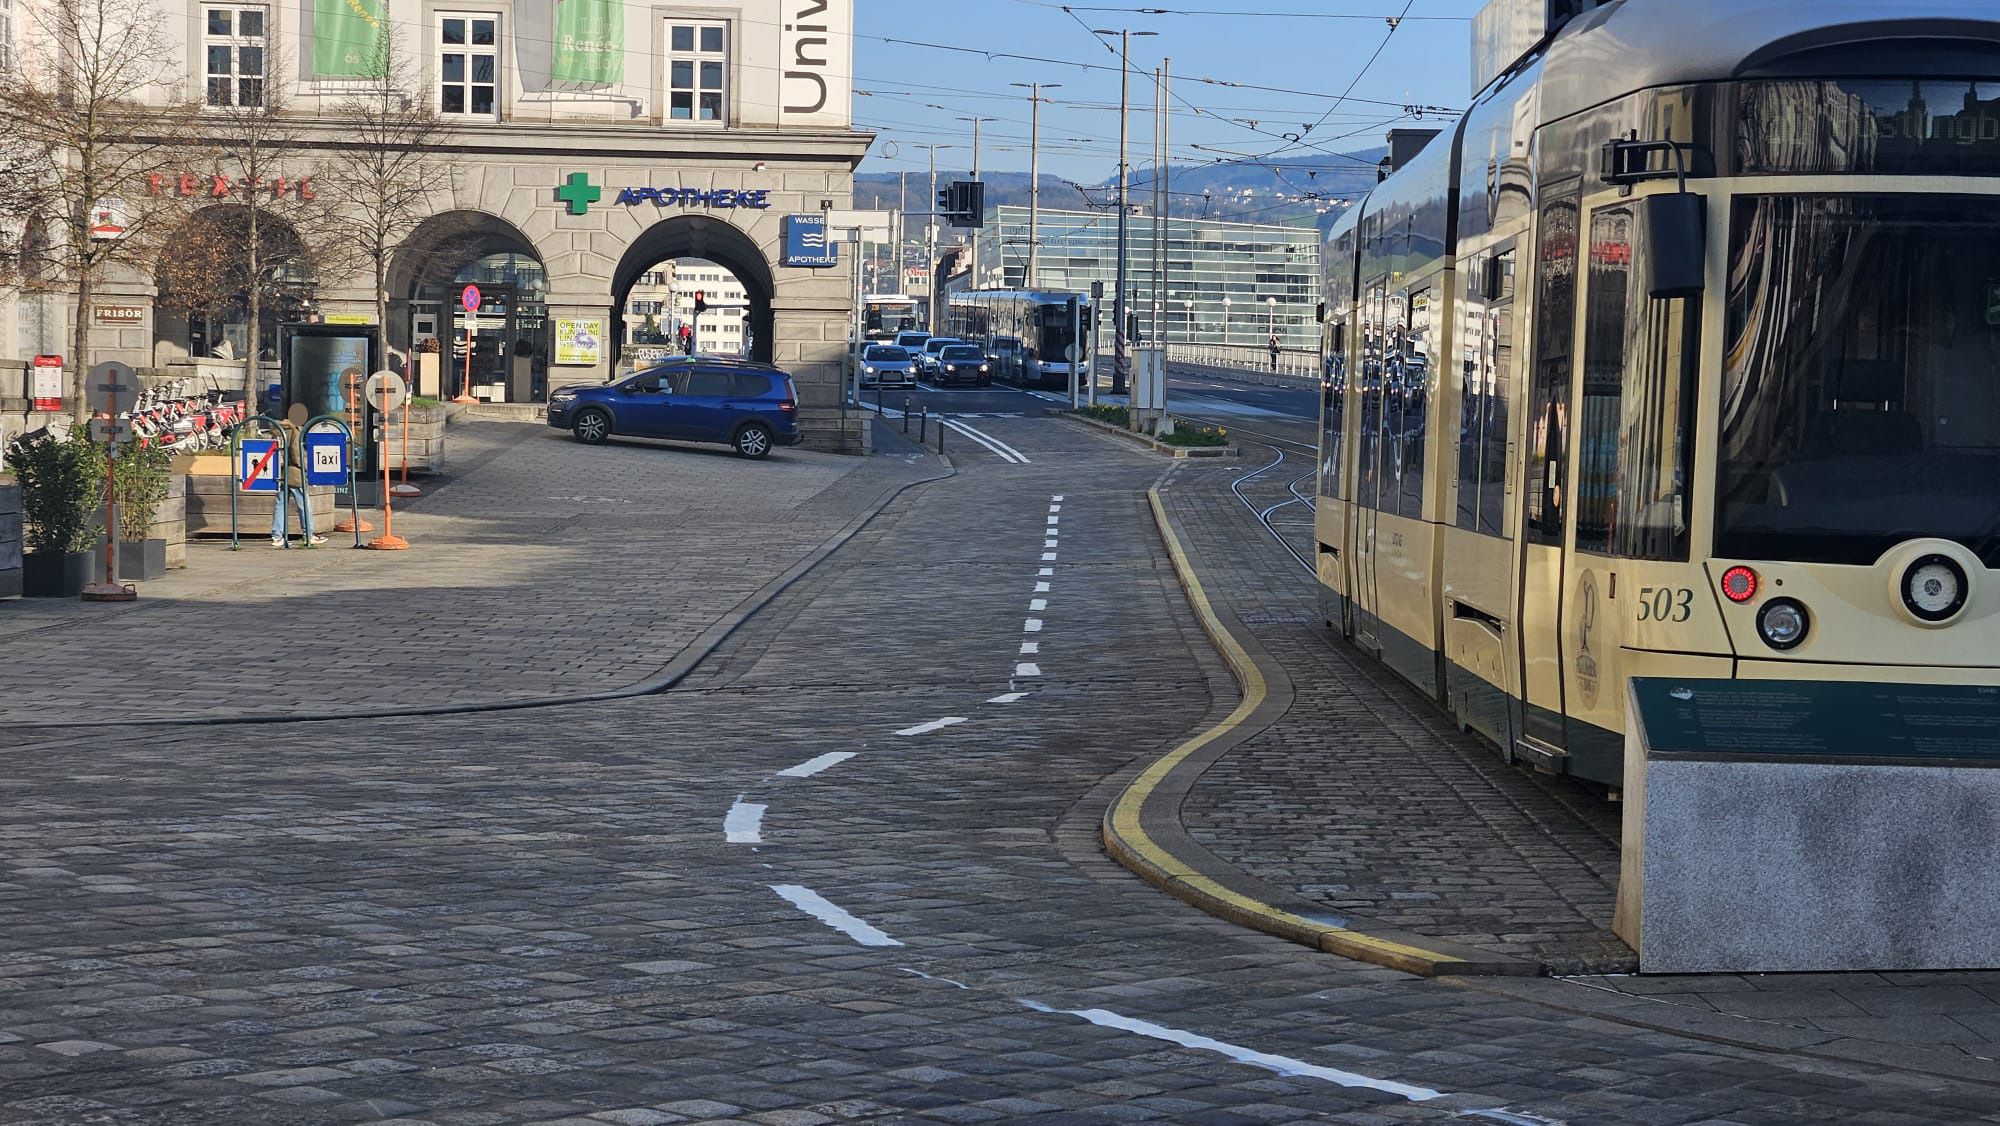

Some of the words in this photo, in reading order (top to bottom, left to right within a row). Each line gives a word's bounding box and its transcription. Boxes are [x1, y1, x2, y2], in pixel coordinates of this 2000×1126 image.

[618, 187, 772, 208] APOTHEKE
[788, 256, 837, 264] APOTHEKE
[96, 308, 142, 318] FRISÖR
[315, 451, 338, 465] Taxi
[1636, 587, 1694, 623] 503
